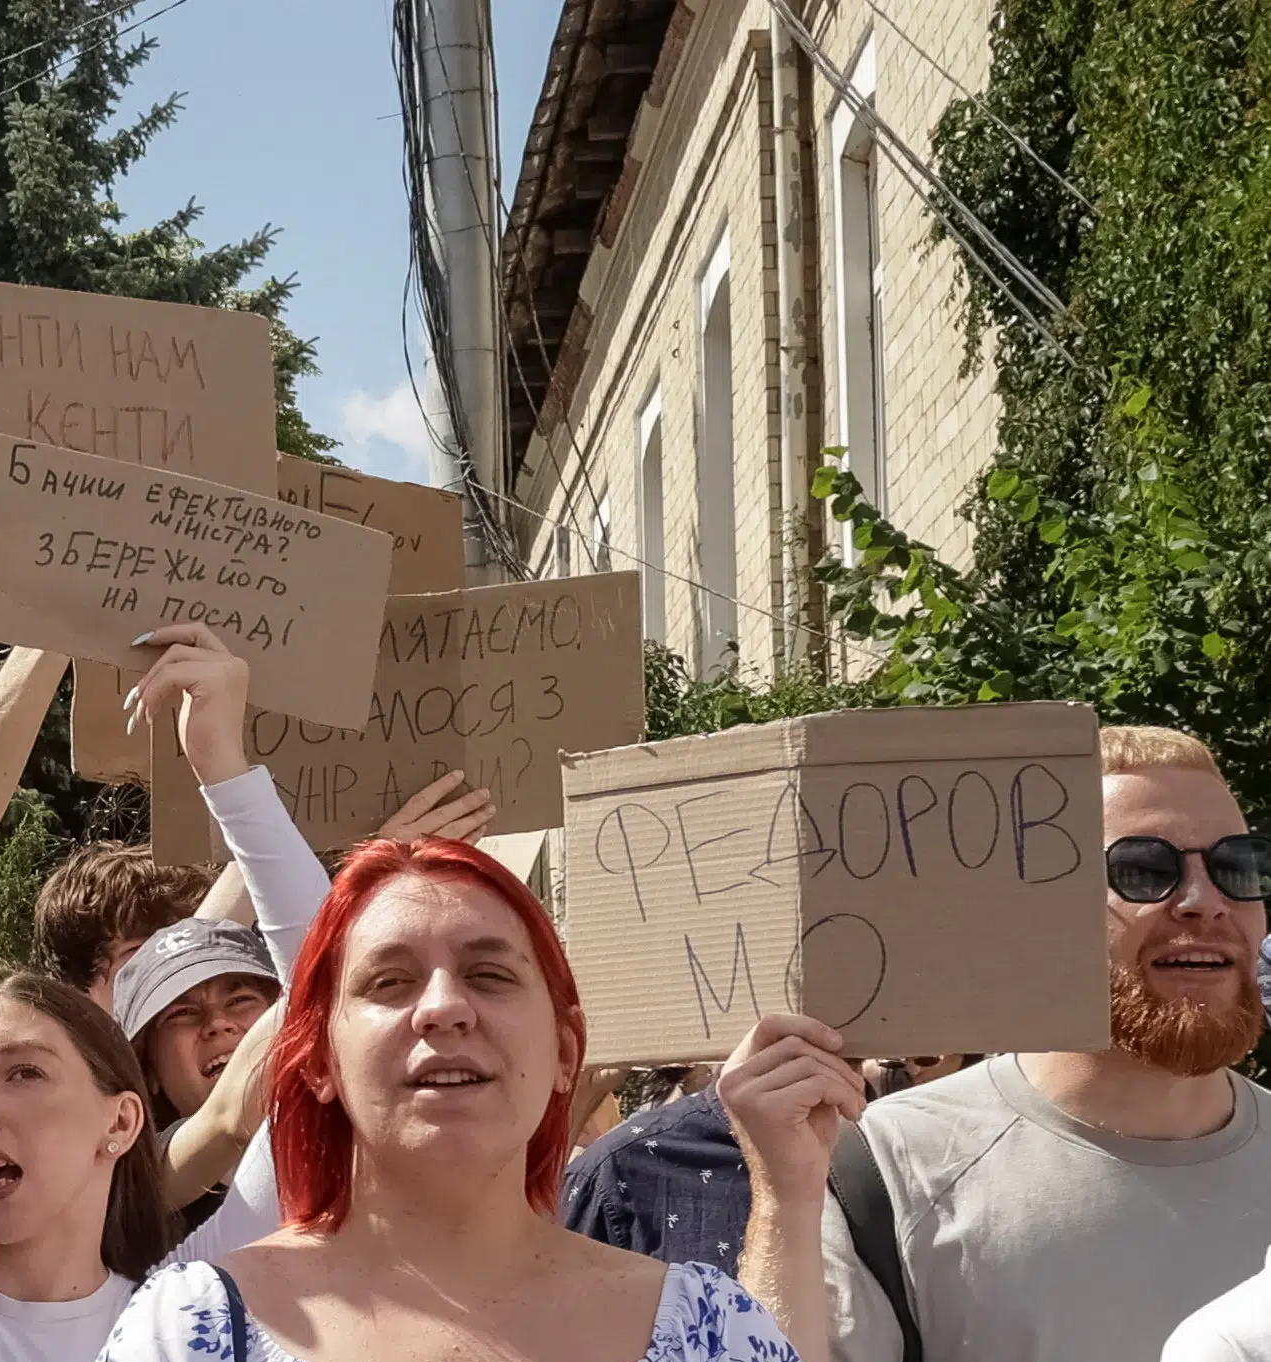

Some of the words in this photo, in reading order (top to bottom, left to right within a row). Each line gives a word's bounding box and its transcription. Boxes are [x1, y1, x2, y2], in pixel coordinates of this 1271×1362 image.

[109, 325, 205, 390] НАМ
[35, 531, 206, 584] ЗБЕРЕЖИ
[101, 585, 139, 612] НА
[300, 680, 515, 744] АЛОСЯ
[595, 763, 1082, 923] ФЕДОРОВ
[683, 913, 887, 1041] МО
